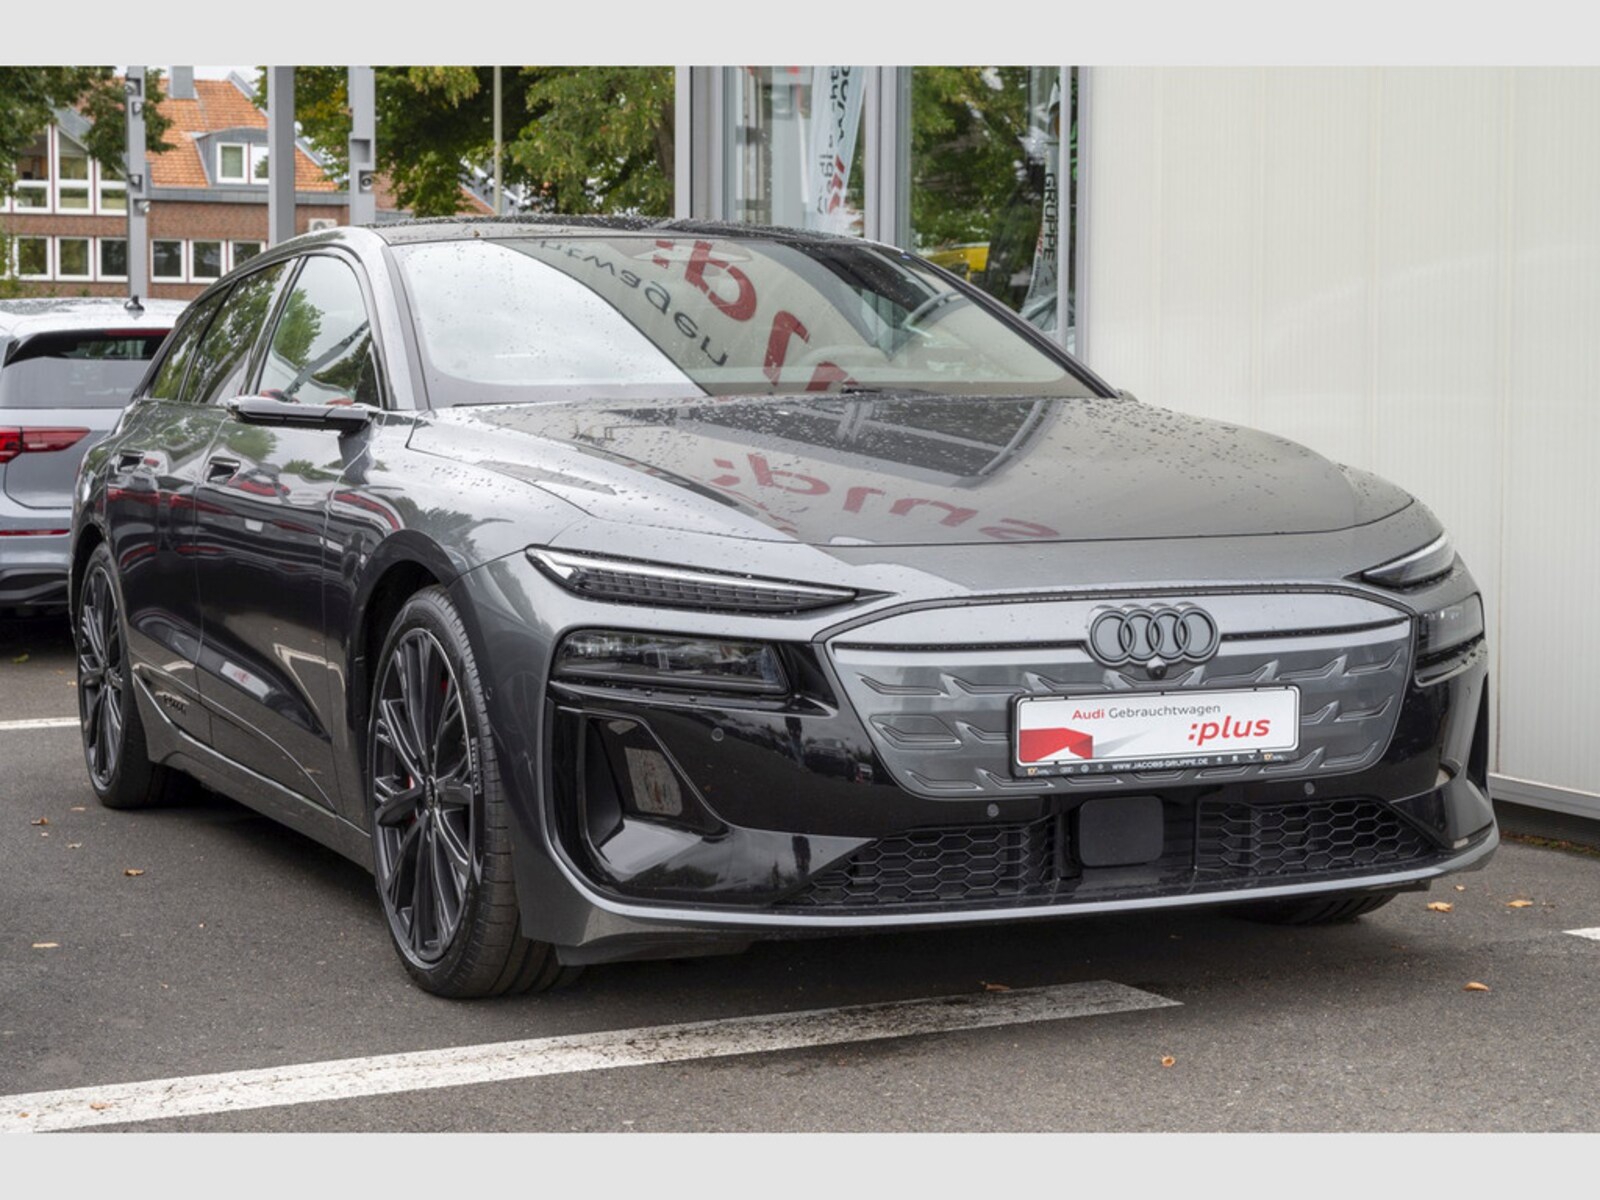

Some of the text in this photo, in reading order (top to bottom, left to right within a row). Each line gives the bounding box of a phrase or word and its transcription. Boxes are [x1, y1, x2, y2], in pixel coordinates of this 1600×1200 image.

[1042, 172, 1058, 262] GRUPPE
[1071, 704, 1221, 720] Audi Gebrauchtwagen
[1188, 715, 1271, 745] :plus
